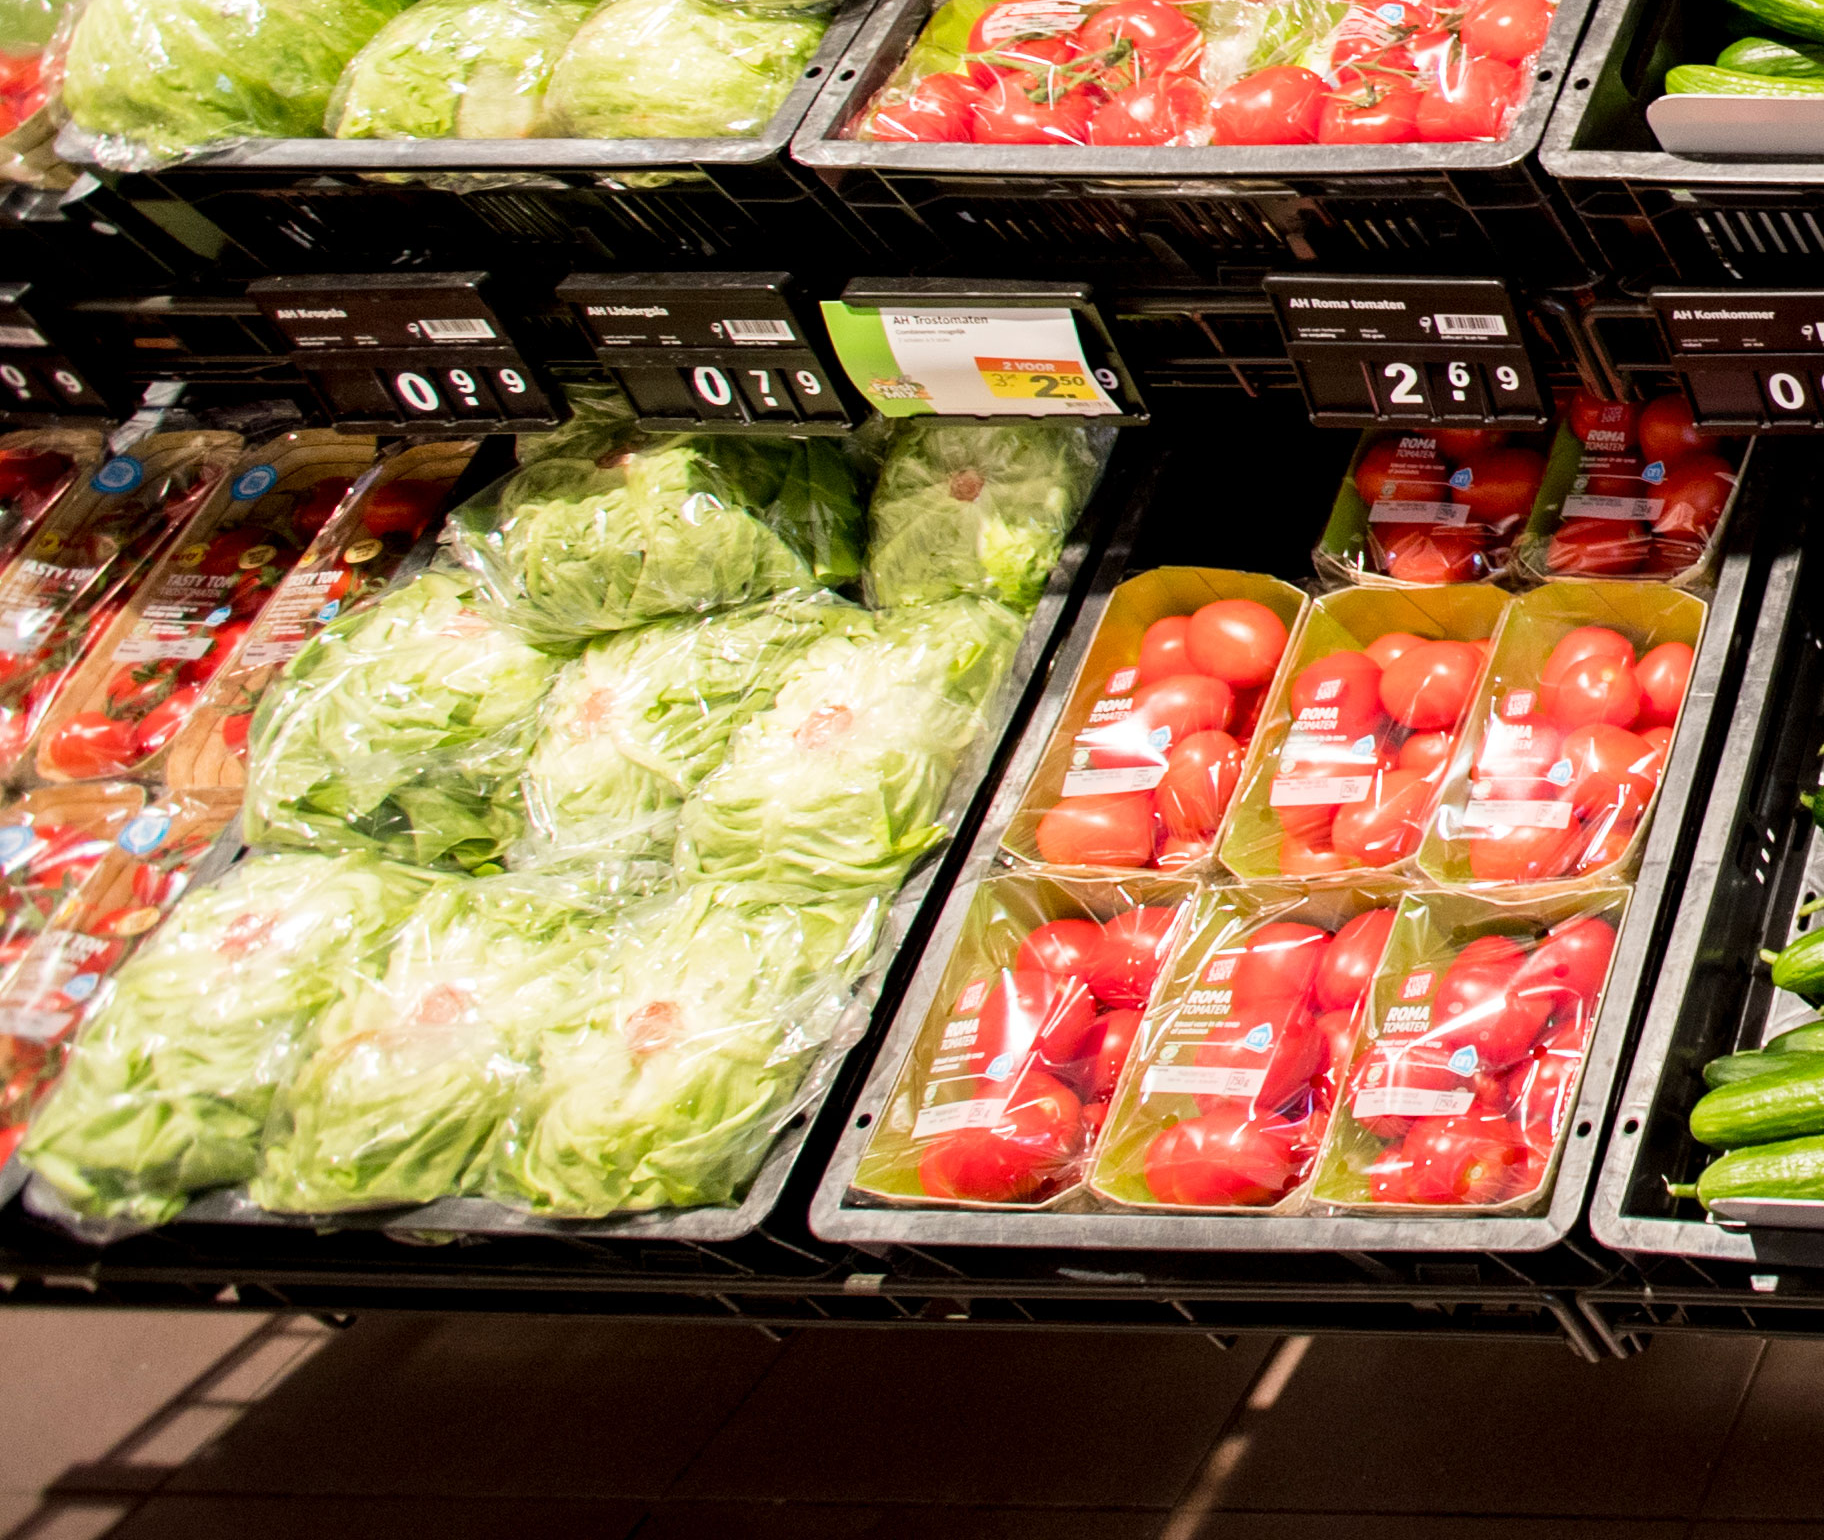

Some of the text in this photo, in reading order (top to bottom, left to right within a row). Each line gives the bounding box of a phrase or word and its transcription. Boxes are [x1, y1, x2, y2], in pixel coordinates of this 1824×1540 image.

[1290, 298, 1406, 310] AH Roma tomaten
[893, 315, 988, 325] AH Trostomaten
[1672, 309, 1775, 320] AH Komkommer
[1003, 361, 1055, 372] 2 VOOR
[1587, 430, 1625, 442] ROMA
[1399, 438, 1436, 449] ROMA
[1585, 442, 1625, 451] TOMATEN
[207, 574, 233, 587] TOM
[316, 570, 345, 583] TOM
[1093, 697, 1133, 713] ROMA
[1298, 707, 1339, 720] ROMA
[1187, 989, 1233, 1004] ROMA
[1182, 1004, 1231, 1015] TOMATEN
[1386, 1006, 1431, 1022] ROMA
[945, 1018, 980, 1039] ROMA
[1383, 1021, 1430, 1033] TOMATEN
